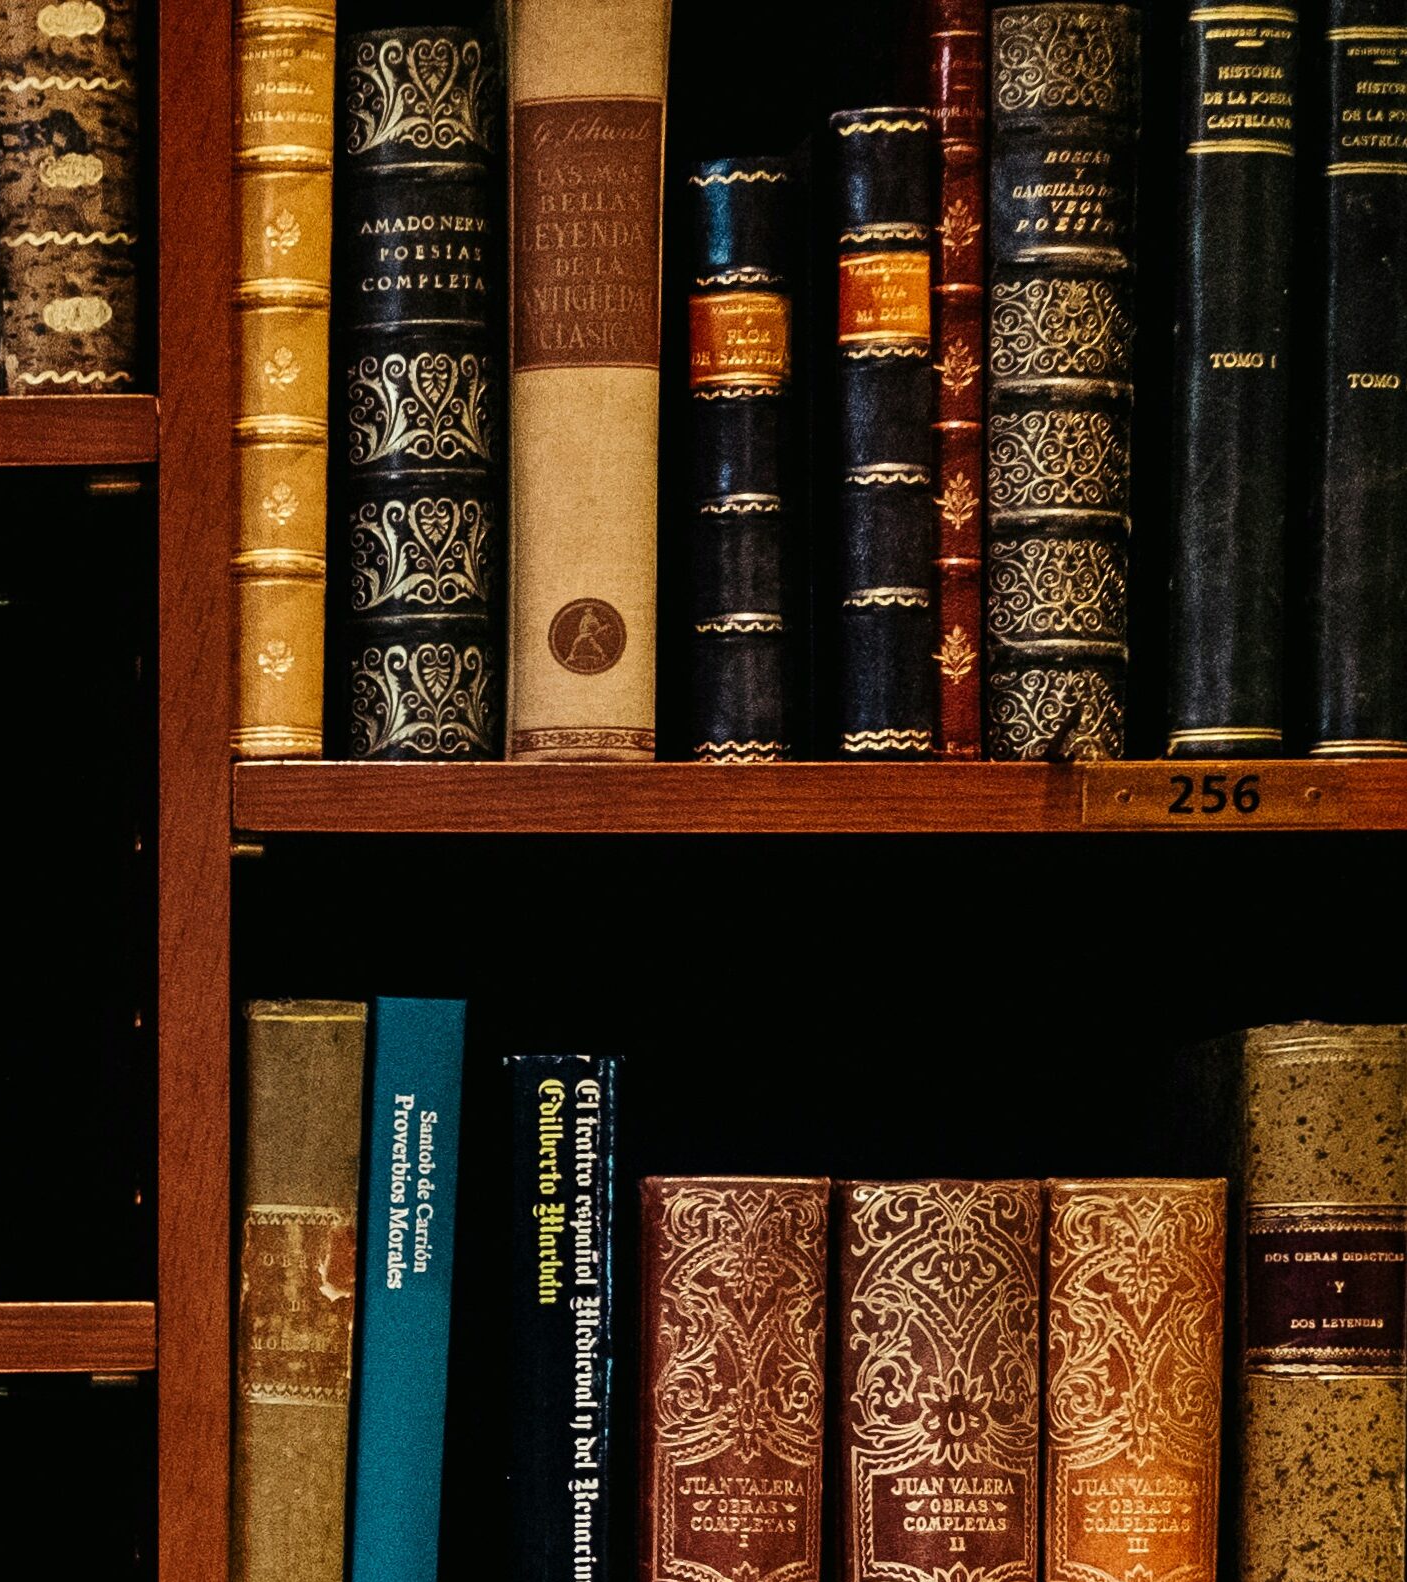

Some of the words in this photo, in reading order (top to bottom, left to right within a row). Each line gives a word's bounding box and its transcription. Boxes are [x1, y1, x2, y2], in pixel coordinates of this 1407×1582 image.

[1218, 65, 1283, 80] HISTORIA
[1347, 373, 1400, 390] TOMO
[1168, 775, 1260, 814] 256
[389, 1094, 415, 1205] Proverbios
[418, 1110, 437, 1176] Santob
[416, 1181, 432, 1199] de
[412, 1202, 433, 1273] Carrión
[386, 1206, 410, 1290] Morales
[1334, 1280, 1345, 1294] Y
[679, 1477, 733, 1495] JUAN
[733, 1477, 805, 1496] VALERA
[890, 1477, 946, 1496] JUAN
[948, 1477, 1016, 1496] VALERA
[717, 1500, 778, 1514] OBRAS
[929, 1499, 988, 1514] OBRAS
[1110, 1499, 1171, 1515] OBRAS
[690, 1516, 796, 1534] COMPLETAS
[902, 1515, 1007, 1533] COMPLETAS
